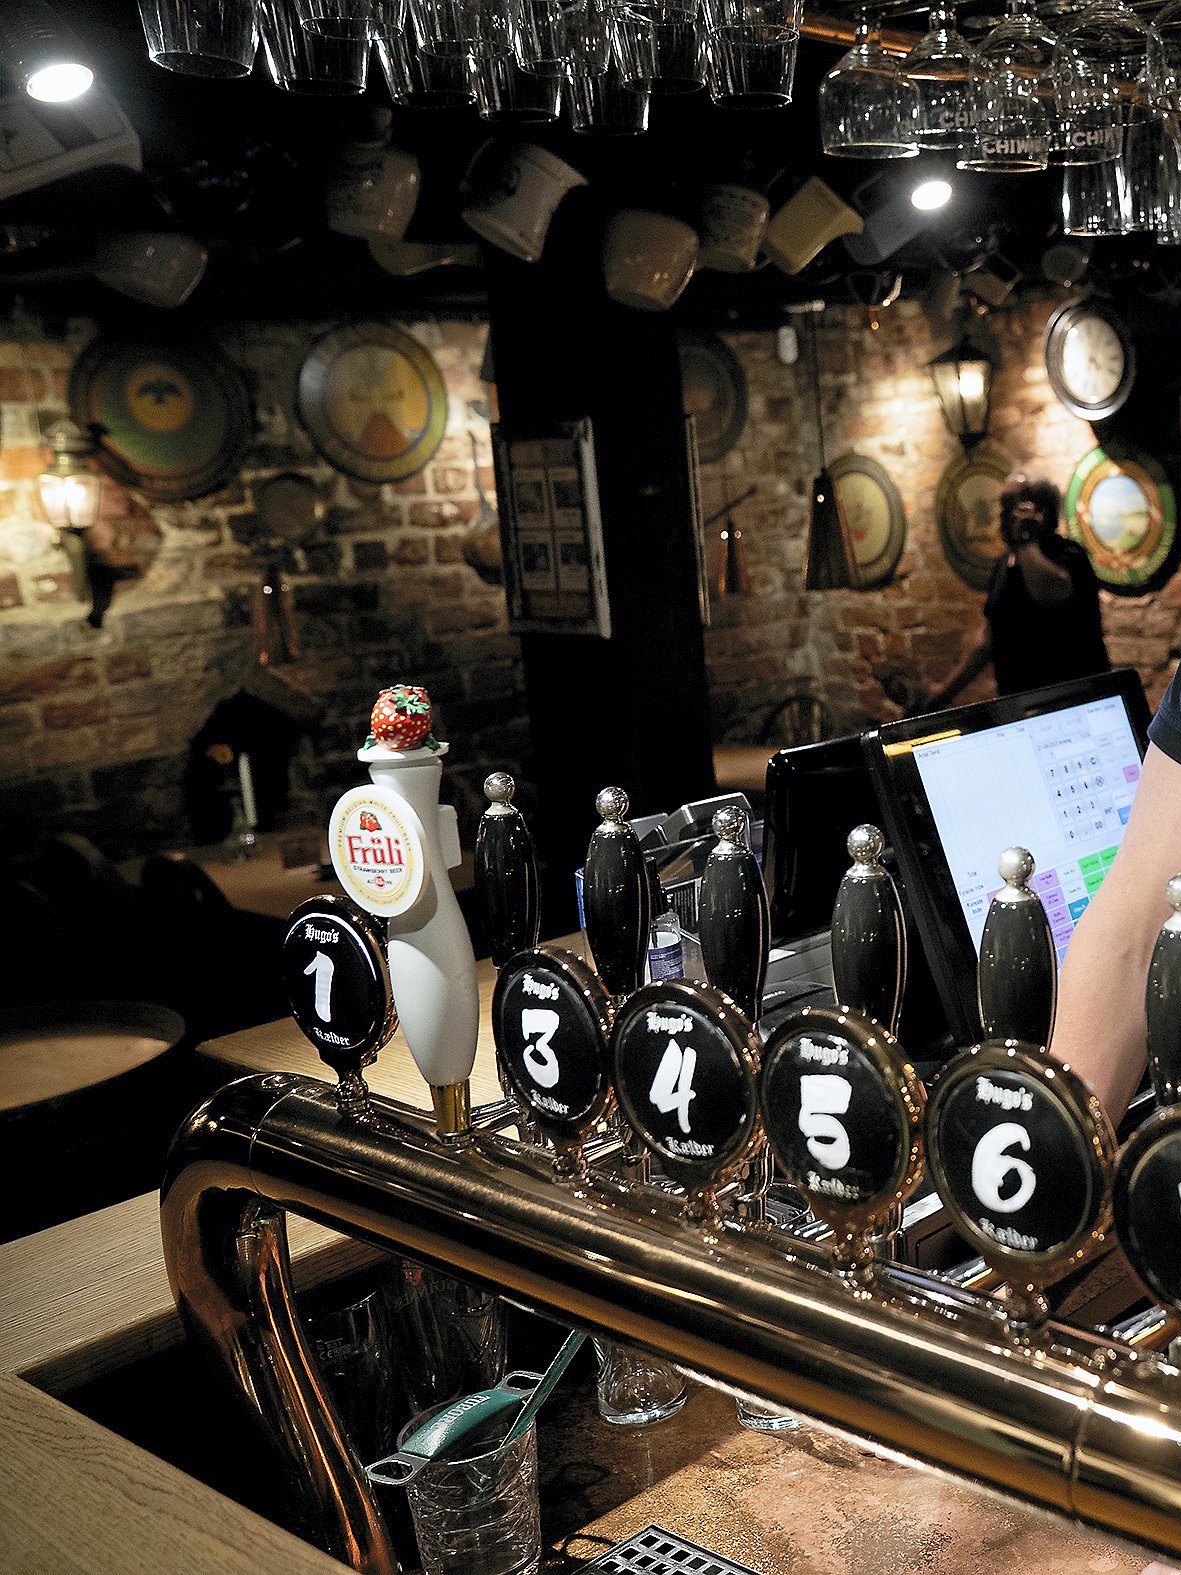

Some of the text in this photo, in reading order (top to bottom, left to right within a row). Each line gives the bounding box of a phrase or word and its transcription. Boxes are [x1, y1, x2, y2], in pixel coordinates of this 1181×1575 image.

[345, 834, 405, 866] Früli
[305, 923, 340, 944] Hugo's
[304, 950, 335, 1023] 1
[522, 973, 560, 1001] Hugo's
[646, 1011, 693, 1035] Hugo's
[521, 1008, 560, 1089] 3
[649, 1038, 698, 1134] 4
[798, 1074, 853, 1171] 5
[971, 1121, 1037, 1214] 6
